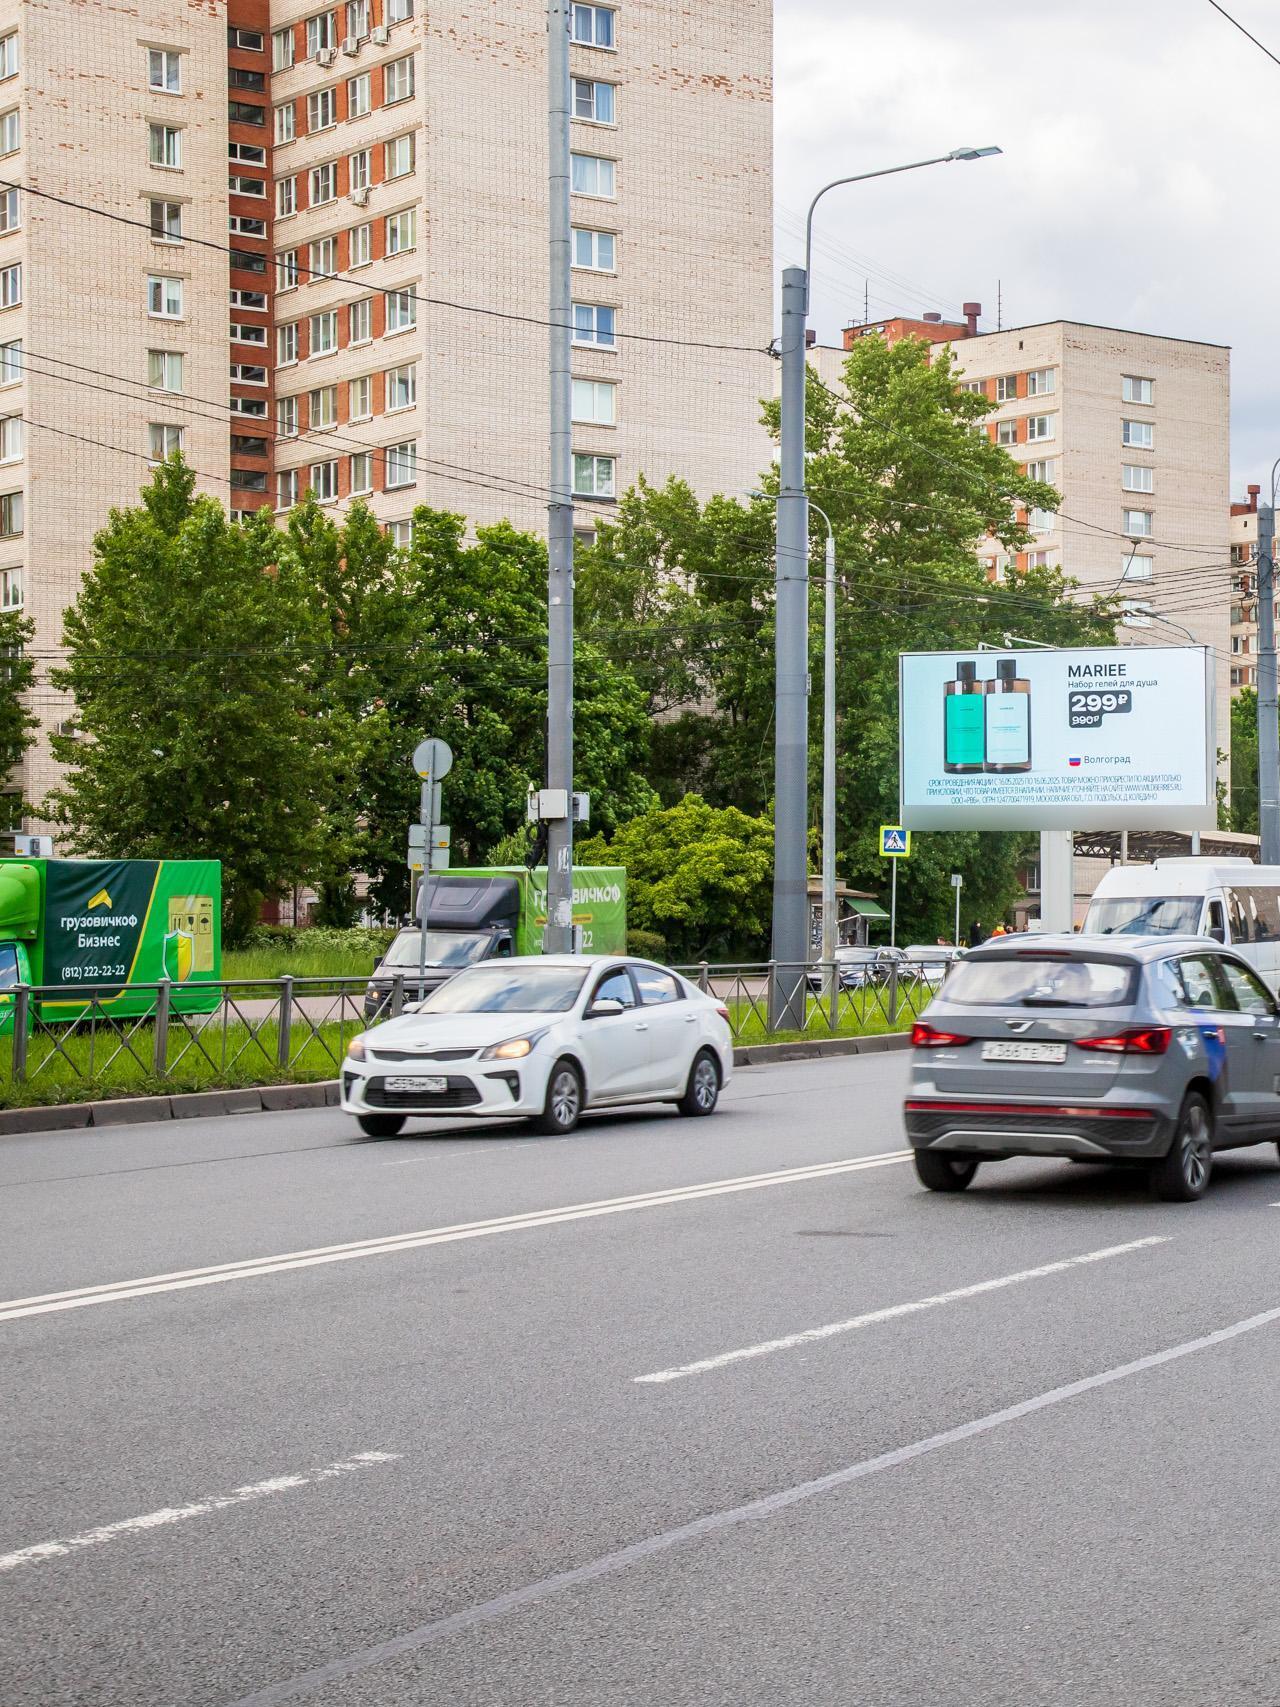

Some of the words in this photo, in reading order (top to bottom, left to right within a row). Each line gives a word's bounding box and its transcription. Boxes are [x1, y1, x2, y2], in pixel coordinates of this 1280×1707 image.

[1068, 664, 1127, 678] MARIEE
[1068, 681, 1093, 689] Набор
[1095, 680, 1117, 688] гелей
[1119, 680, 1134, 688] для
[1136, 680, 1158, 688] душа
[1084, 756, 1131, 764] Волгоград
[61, 914, 137, 931] грузовичкоф
[78, 933, 121, 948] Бизнес
[61, 967, 82, 980] (812)
[84, 965, 125, 977] 222-22-22
